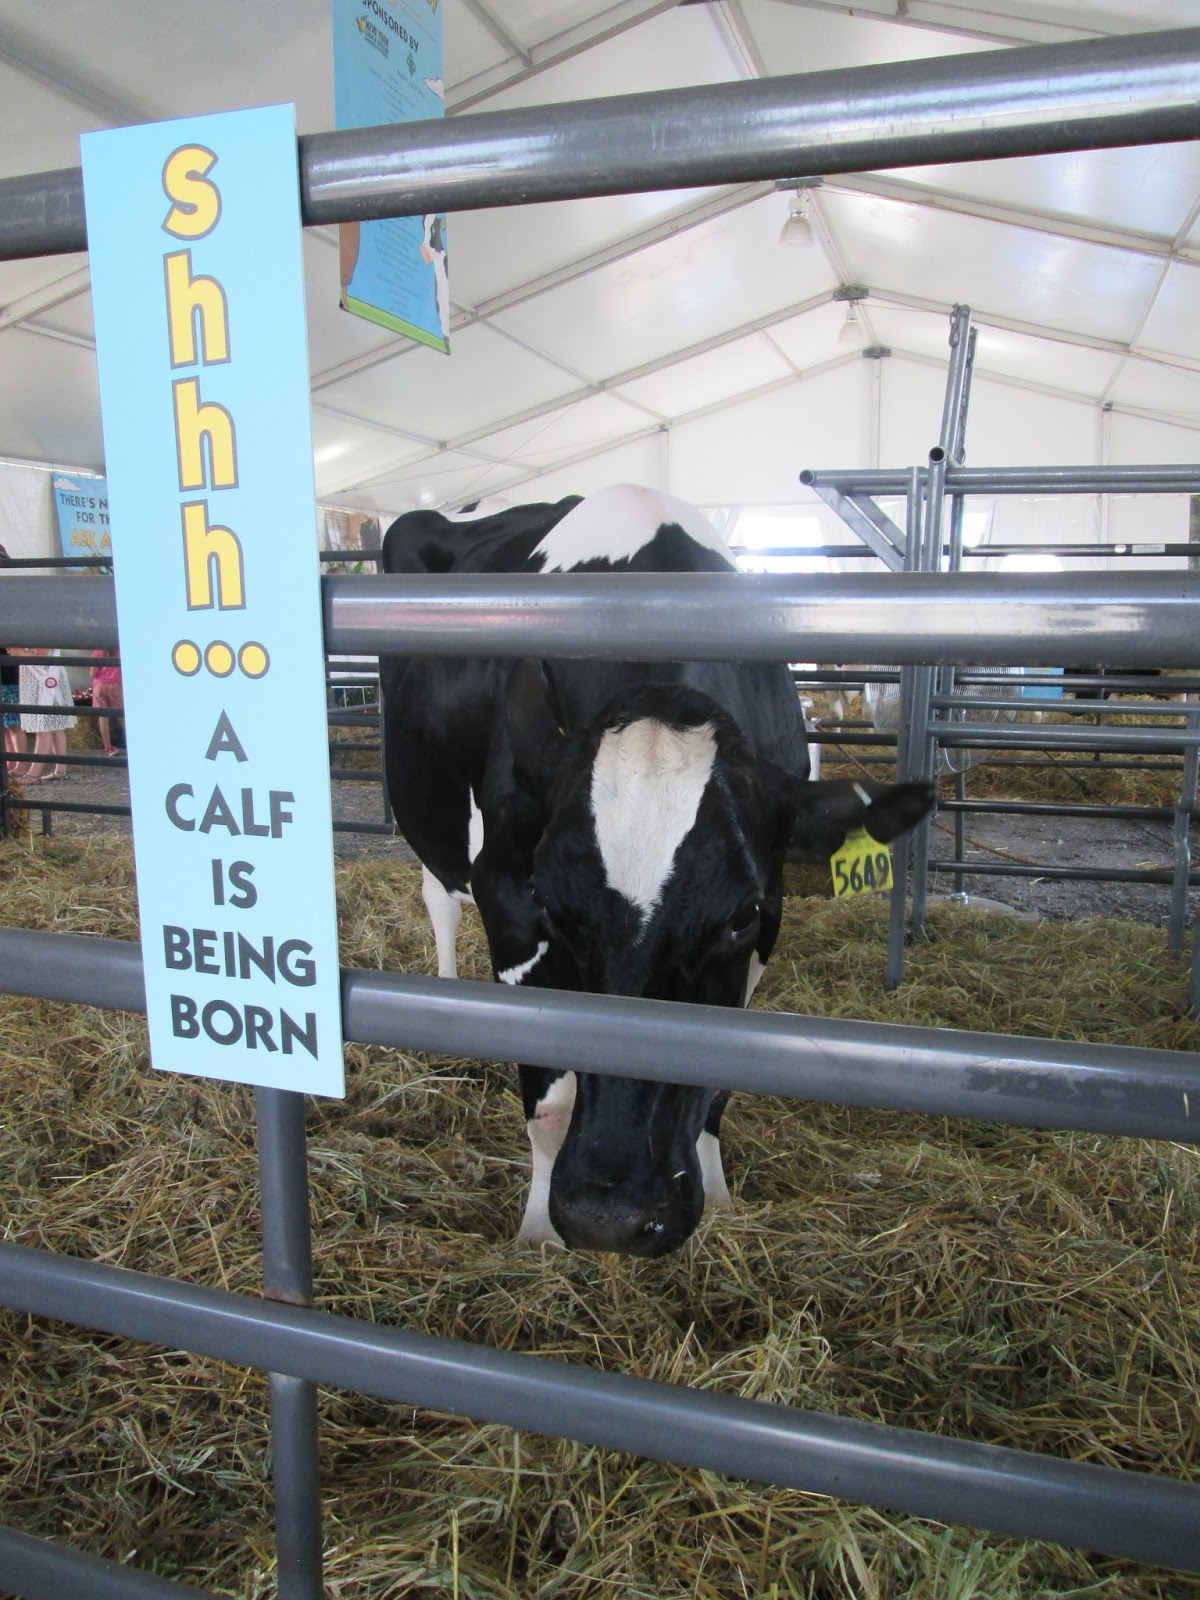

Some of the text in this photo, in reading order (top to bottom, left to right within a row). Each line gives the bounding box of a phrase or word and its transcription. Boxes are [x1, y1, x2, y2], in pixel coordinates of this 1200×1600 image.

[409, 35, 419, 54] BY
[60, 493, 96, 509] THERE'S
[76, 511, 96, 524] FOR
[70, 527, 97, 548] ASK
[204, 708, 249, 763] A
[164, 782, 296, 839] CALF
[211, 858, 258, 909] IS
[835, 853, 890, 896] 5649
[162, 924, 317, 988] BEING
[169, 993, 319, 1061] BORN
